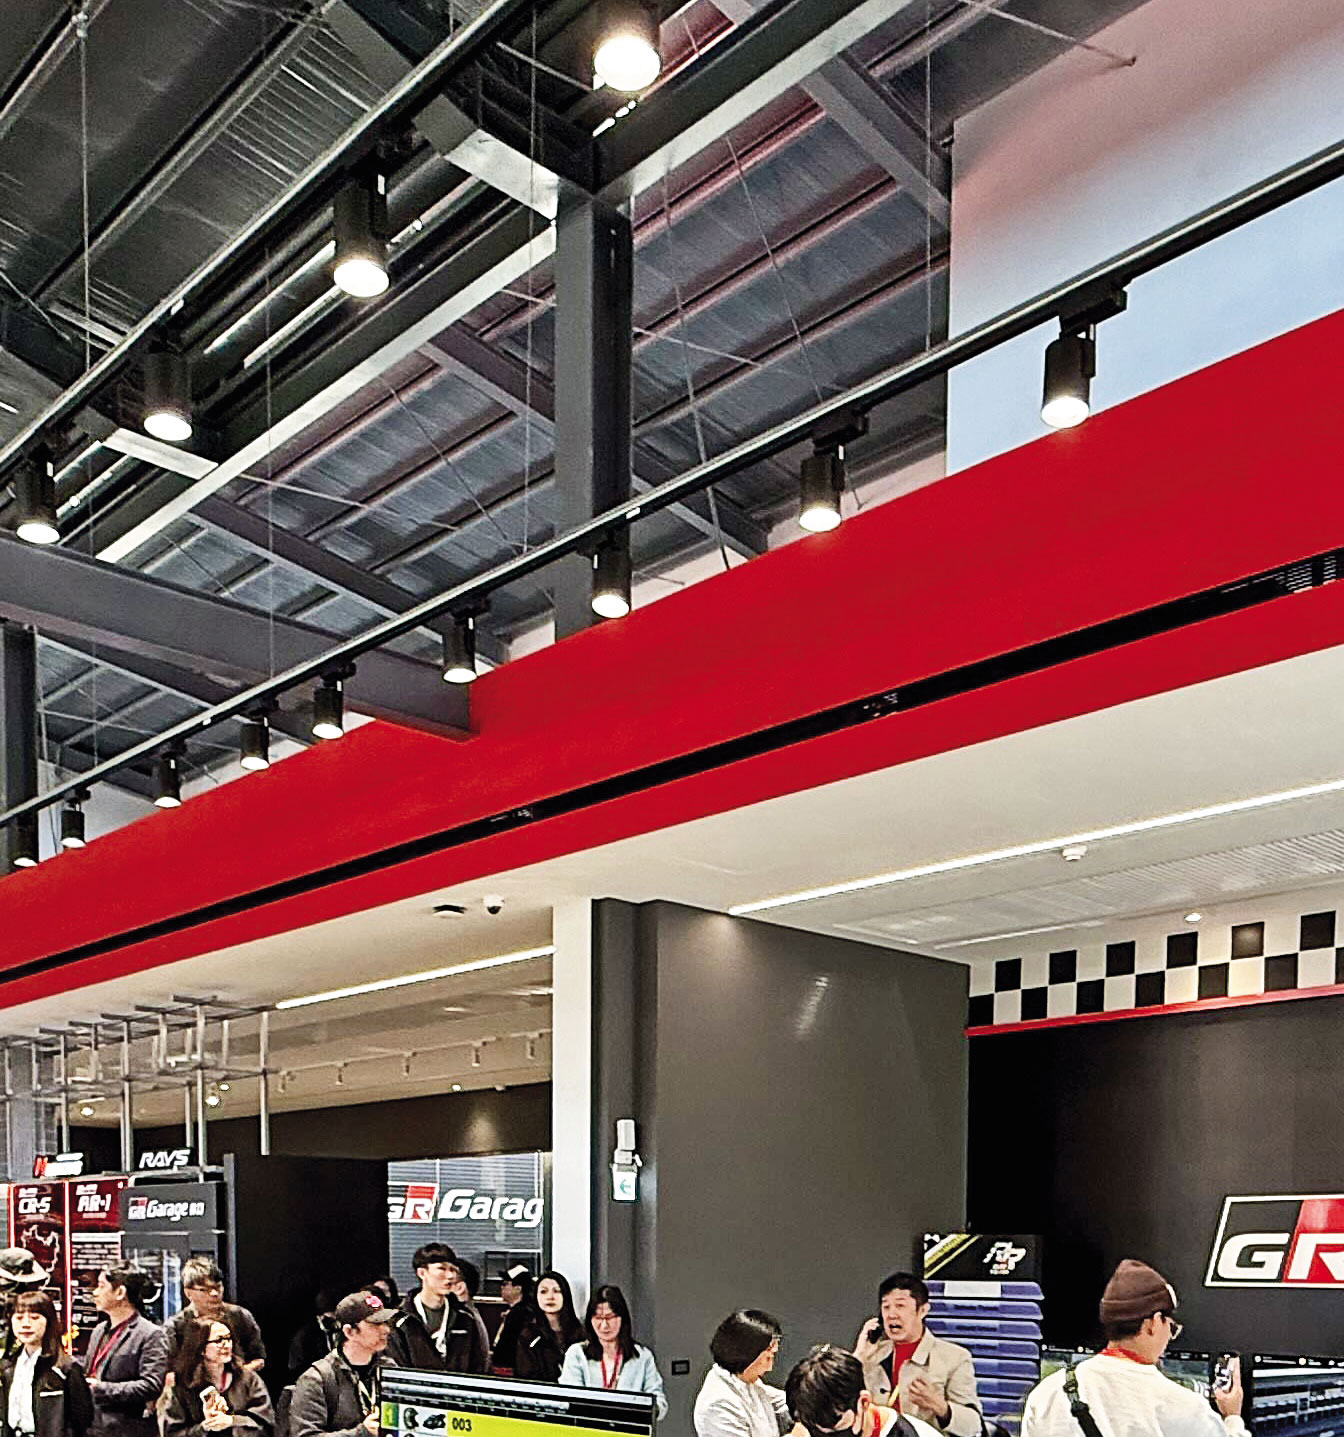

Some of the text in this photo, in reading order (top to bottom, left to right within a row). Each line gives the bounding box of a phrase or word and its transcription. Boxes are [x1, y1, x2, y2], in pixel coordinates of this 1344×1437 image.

[139, 1149, 191, 1169] RAYS
[147, 1200, 189, 1221] Garage
[438, 1189, 544, 1228] Garag
[385, 1407, 473, 1432] 1 003
